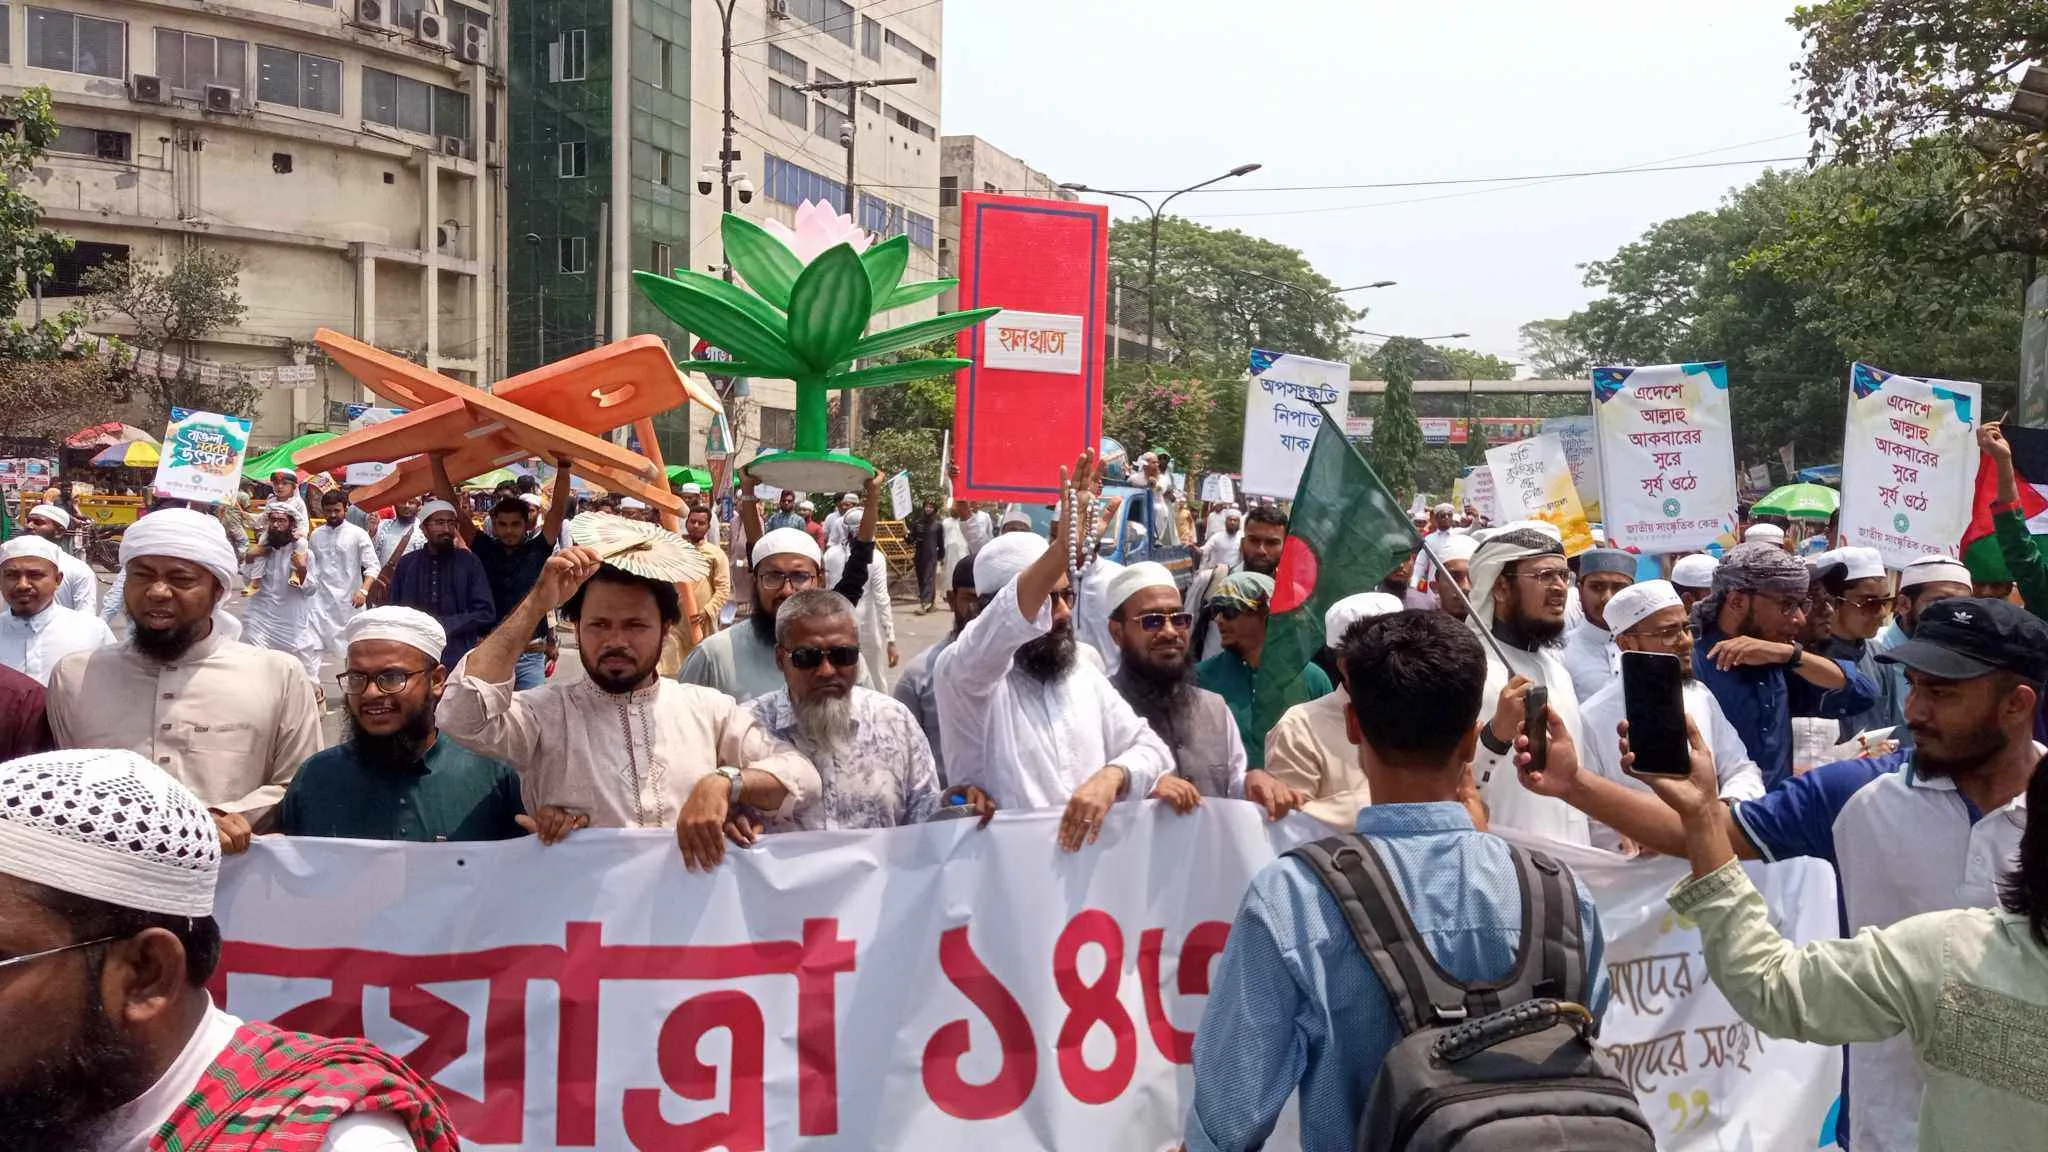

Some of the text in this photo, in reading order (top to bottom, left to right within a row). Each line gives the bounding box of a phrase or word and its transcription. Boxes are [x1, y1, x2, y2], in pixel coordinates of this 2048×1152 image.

[998, 328, 1068, 355] হালখাতা
[1633, 384, 1684, 401] এদেশে
[1273, 403, 1322, 428] নিপাত
[1640, 407, 1688, 425] আল্লাহু
[1887, 394, 1933, 419] এদেশে
[1280, 433, 1311, 452] যাক
[1627, 429, 1702, 448] আকবারের
[1888, 417, 1930, 445] আল্লাহু
[1652, 451, 1683, 471] সুরে
[1874, 437, 1940, 468] আকবারের
[1640, 470, 1698, 498] সূর্য ওঠে
[1892, 464, 1919, 485] সুরে
[1878, 485, 1929, 512] সূর্য ওঠে
[1608, 951, 1693, 1017] মাদের
[206, 917, 856, 1152] যাত্রা
[1603, 1030, 1689, 1093] মাদের
